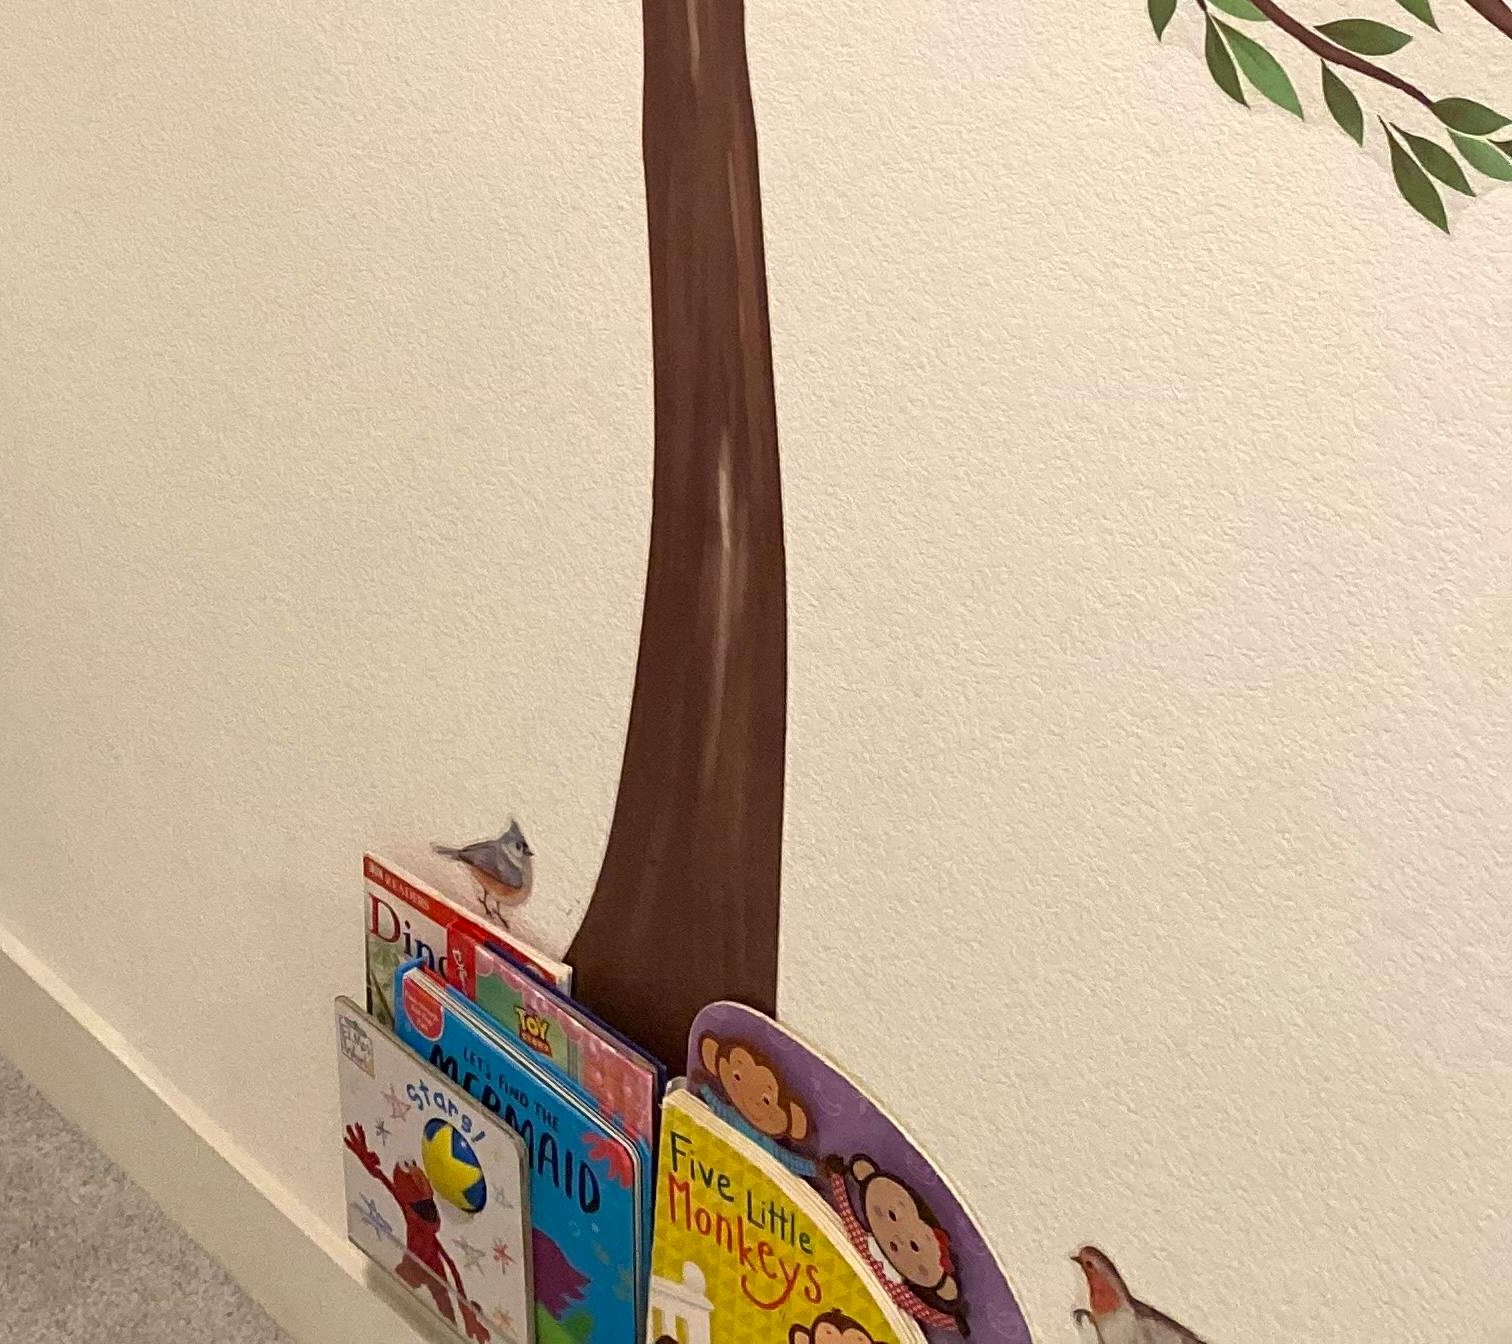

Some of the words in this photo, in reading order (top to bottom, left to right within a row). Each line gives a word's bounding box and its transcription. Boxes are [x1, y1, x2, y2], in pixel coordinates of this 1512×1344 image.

[512, 1004, 551, 1041] TOY
[498, 1073, 530, 1109] FIND
[534, 1100, 561, 1133] THE
[670, 1130, 735, 1203] Five
[746, 1188, 814, 1256] Little
[667, 1171, 824, 1311] Monkeys
